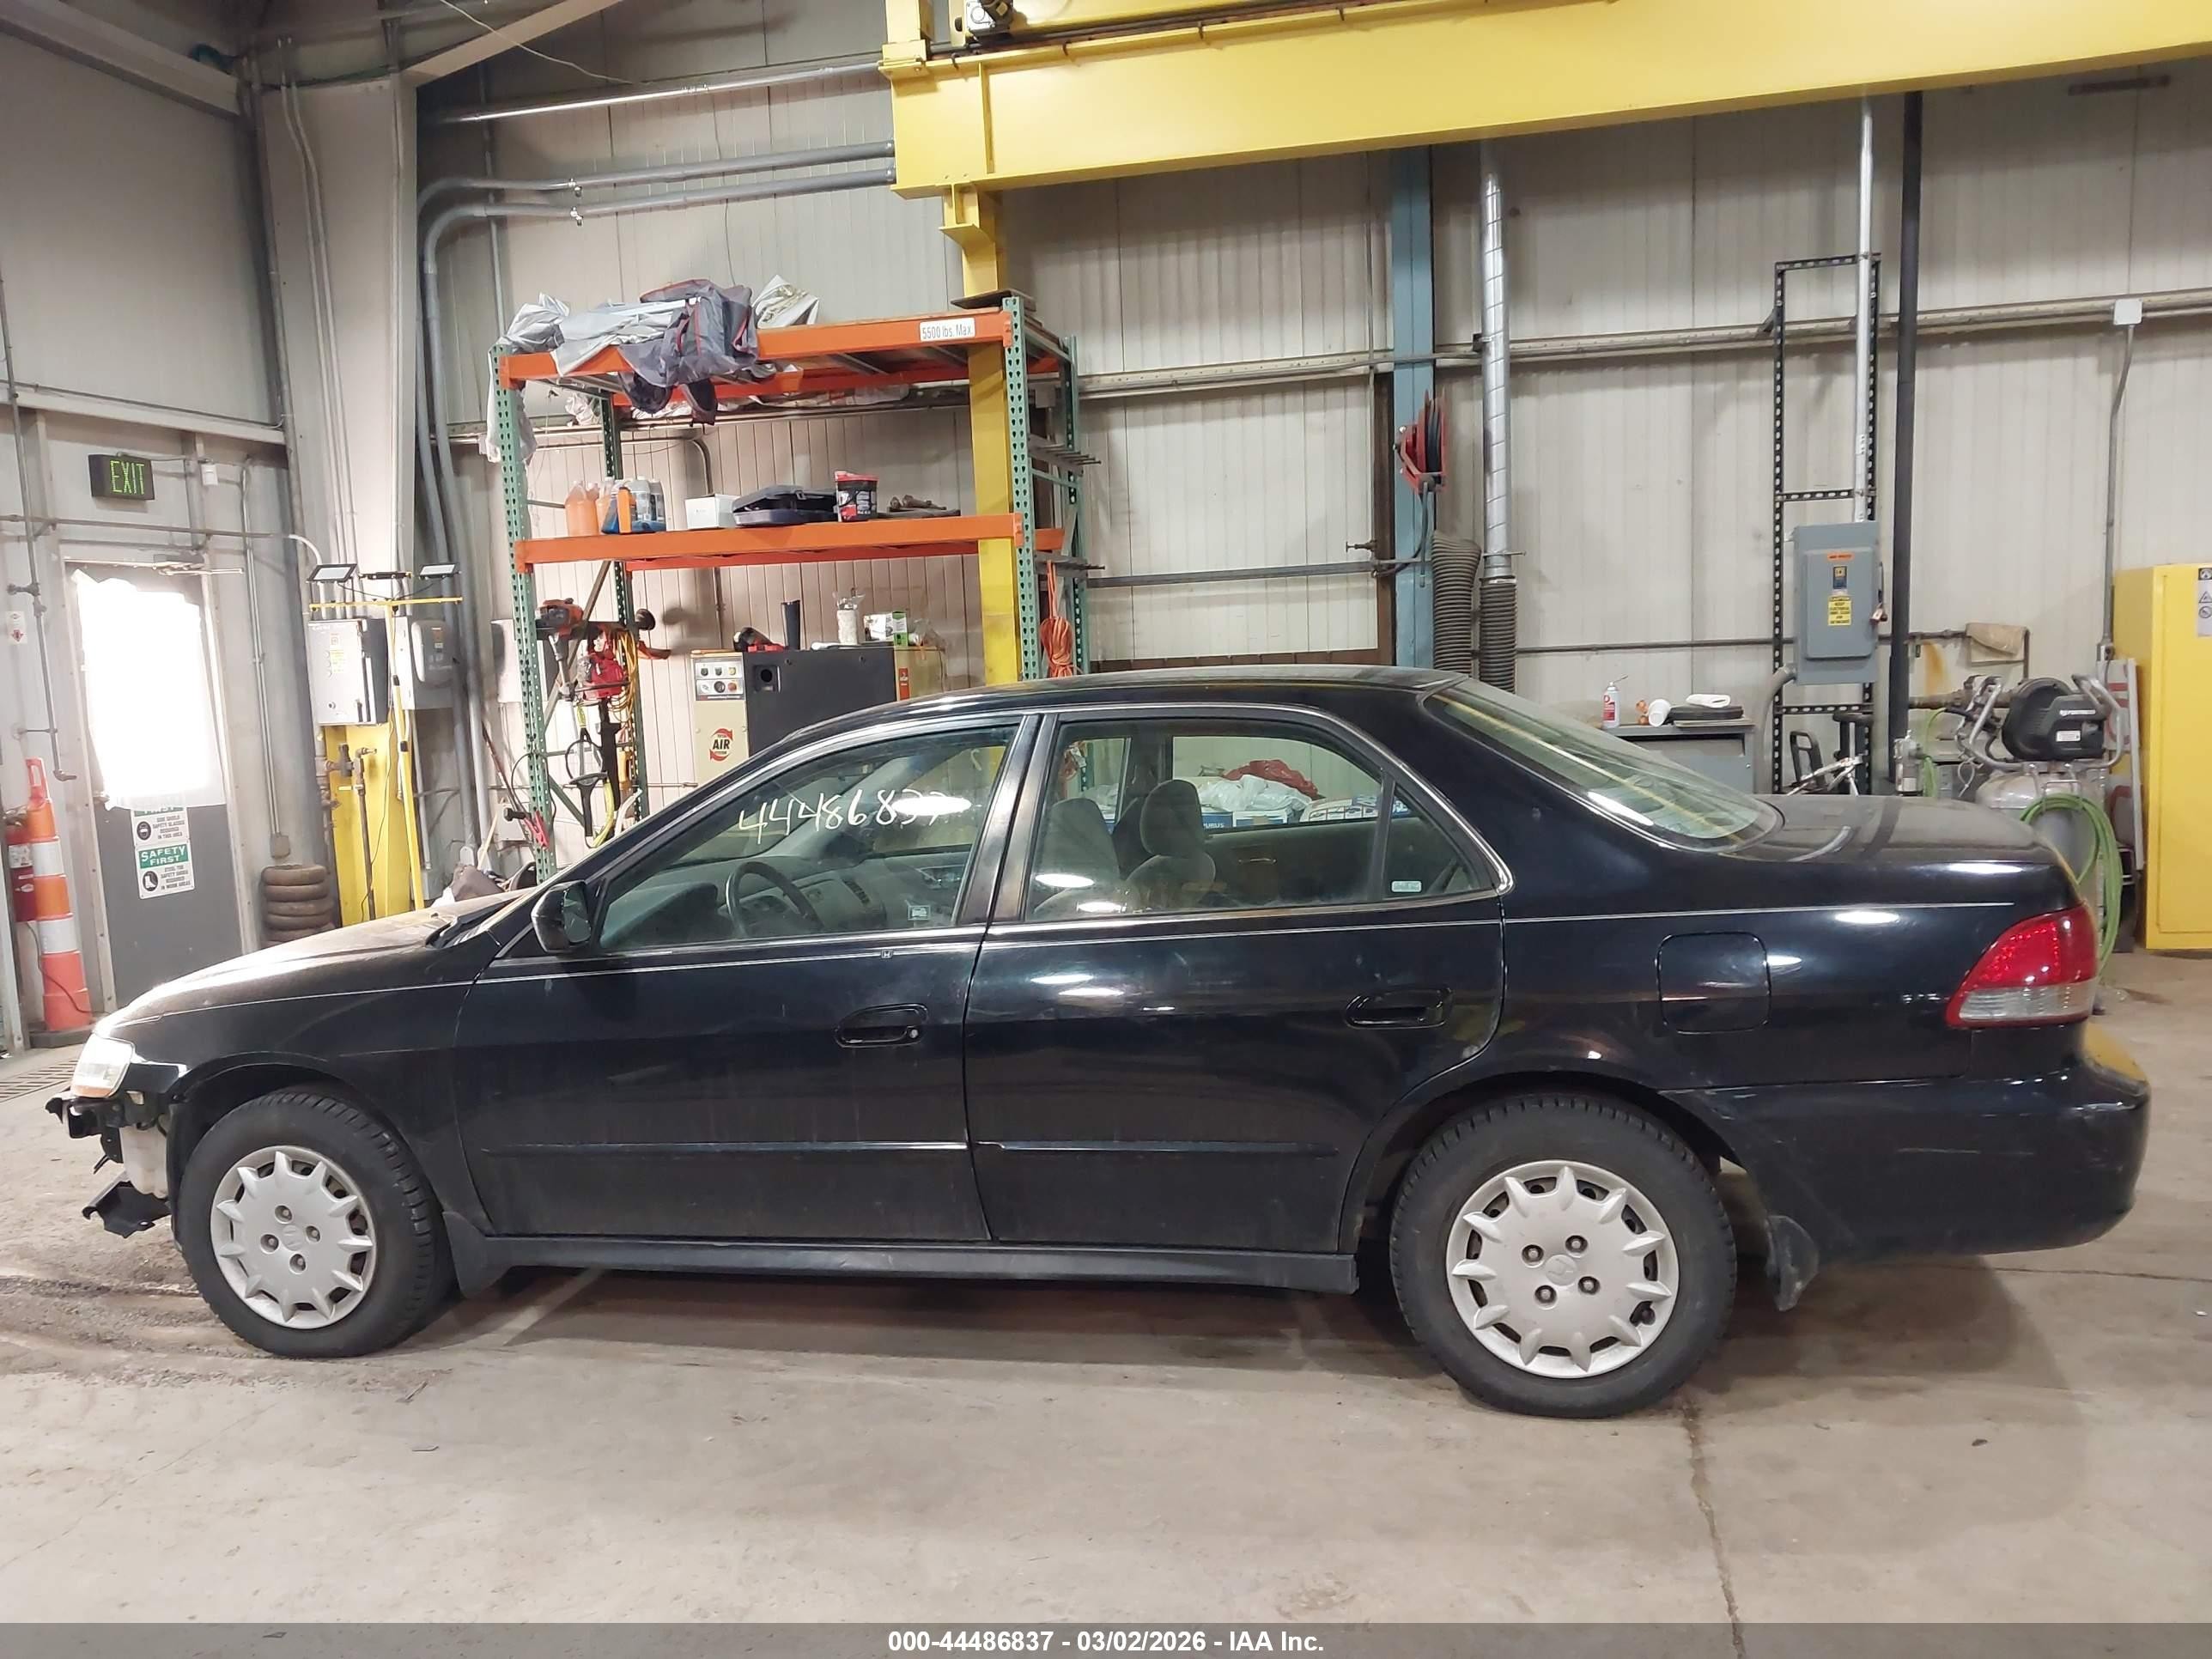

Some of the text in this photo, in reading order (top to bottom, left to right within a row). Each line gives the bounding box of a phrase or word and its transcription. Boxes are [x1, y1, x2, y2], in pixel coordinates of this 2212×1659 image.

[110, 459, 145, 495] EXIT
[713, 738, 730, 750] AIR
[141, 846, 185, 862] SAFETY
[149, 856, 179, 866] FIRST
